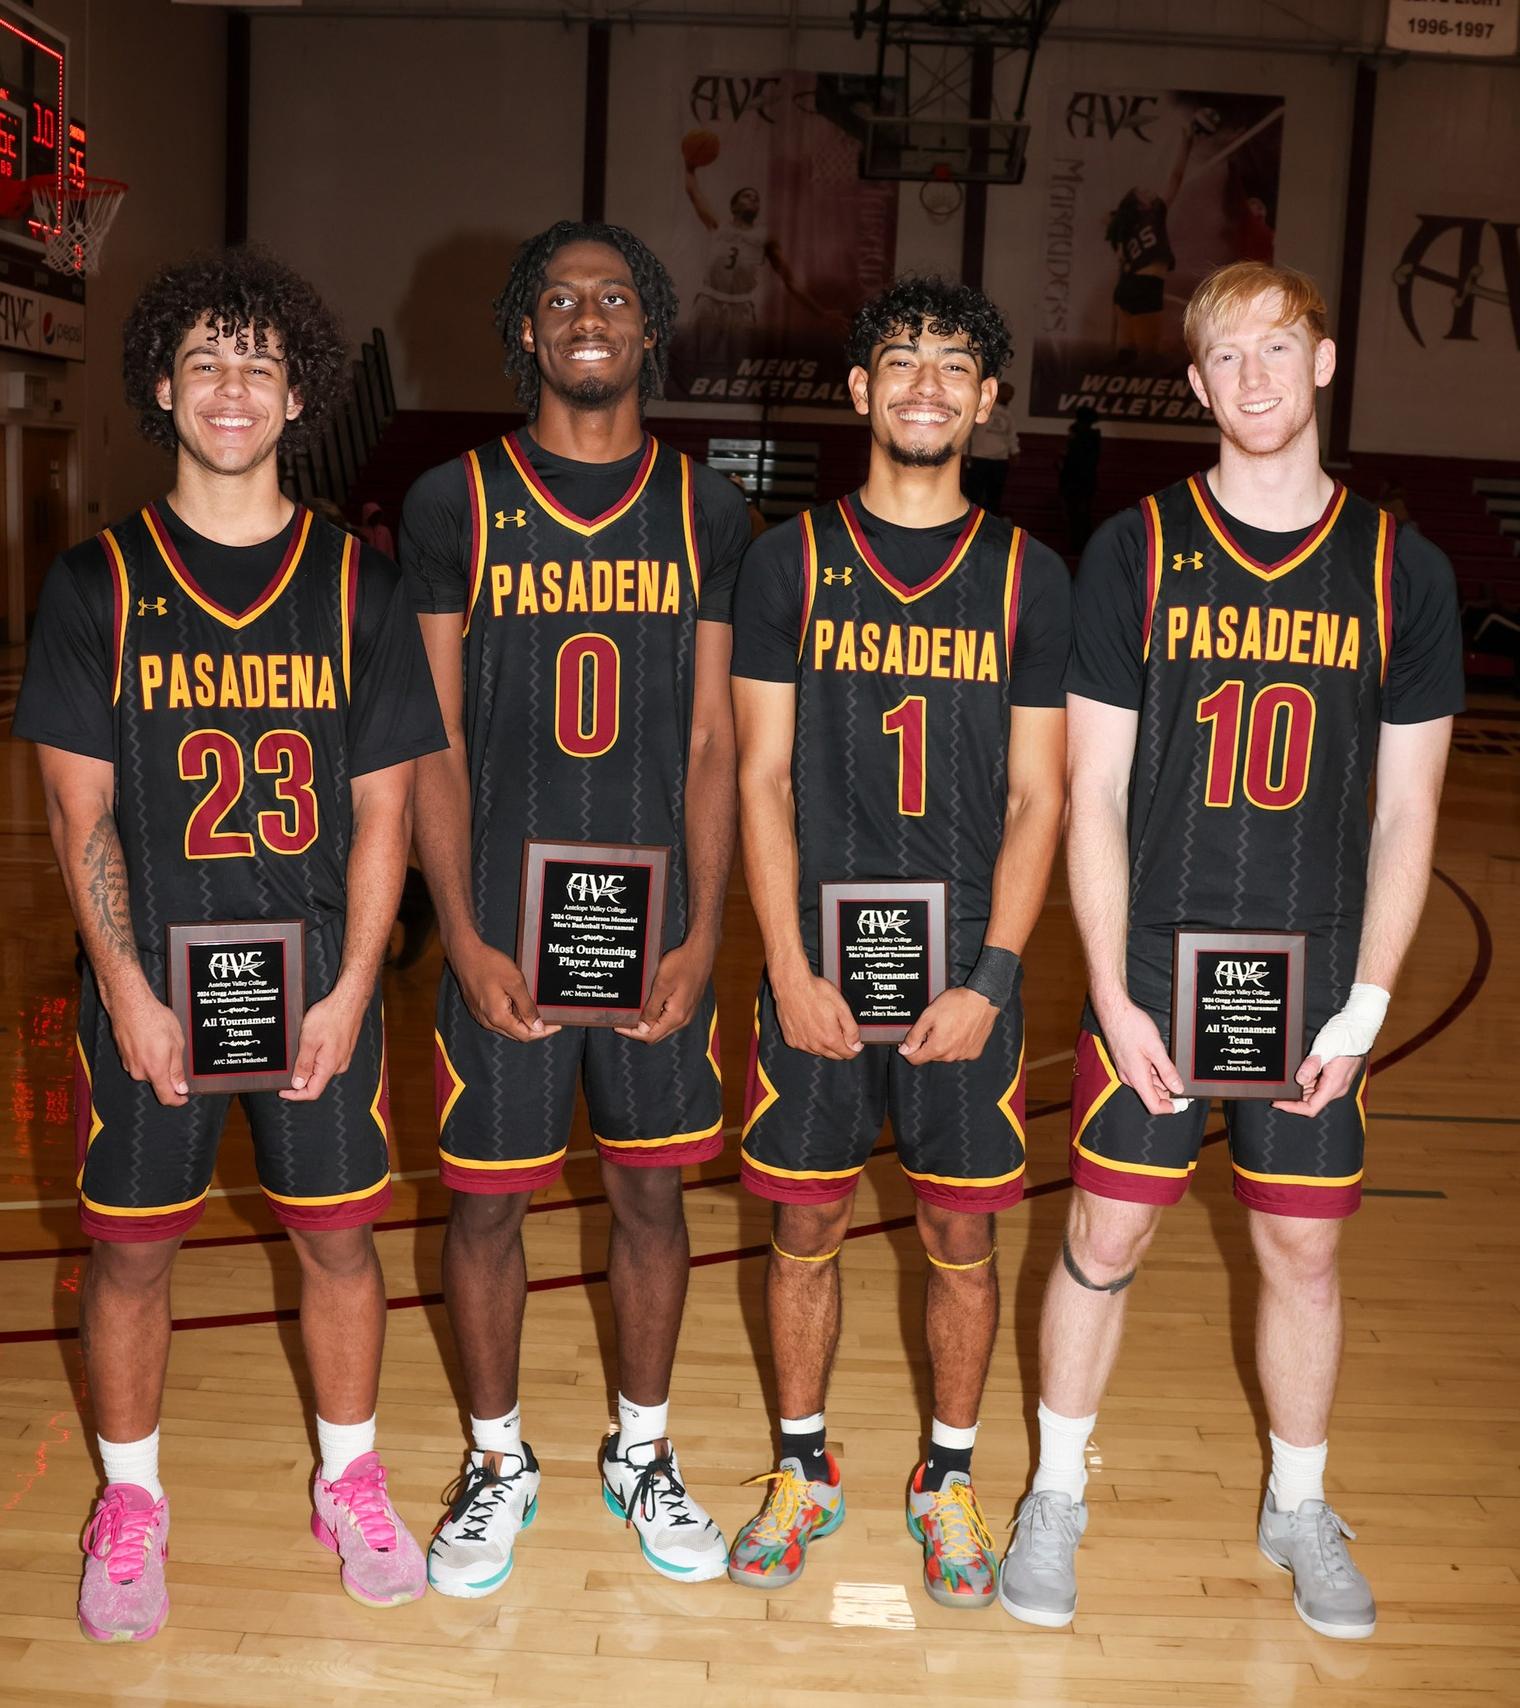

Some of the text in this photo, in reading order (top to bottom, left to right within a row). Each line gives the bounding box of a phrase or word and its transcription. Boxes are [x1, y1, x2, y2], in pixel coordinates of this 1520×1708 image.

[1408, 18, 1494, 38] 1996-1997
[690, 75, 781, 124] AVC
[1067, 92, 1160, 143] AVC
[725, 246, 740, 270] 3
[736, 358, 818, 379] MEN'S
[688, 377, 850, 401] BASKETBAL
[1079, 374, 1191, 398] WOMEN
[1057, 393, 1216, 421] VOLLEYBAL
[491, 560, 680, 616] PASADENA
[814, 619, 998, 682] PASADENA
[1167, 606, 1360, 671] PASADENA
[140, 654, 336, 710] PASADENA
[555, 632, 620, 758] 0
[883, 695, 926, 817] 1
[1196, 680, 1316, 810] 10
[178, 729, 318, 860] 23
[567, 873, 626, 904] AVC
[857, 910, 910, 935] AVC
[548, 944, 636, 958] Most Outstanding
[559, 957, 624, 968] Player Award
[209, 952, 265, 979] AVC
[1215, 961, 1270, 987] AVC
[203, 1016, 275, 1027] All Tournament
[227, 1028, 252, 1037] Team
[1206, 1025, 1276, 1034] All Tournament
[1229, 1036, 1253, 1044] Team
